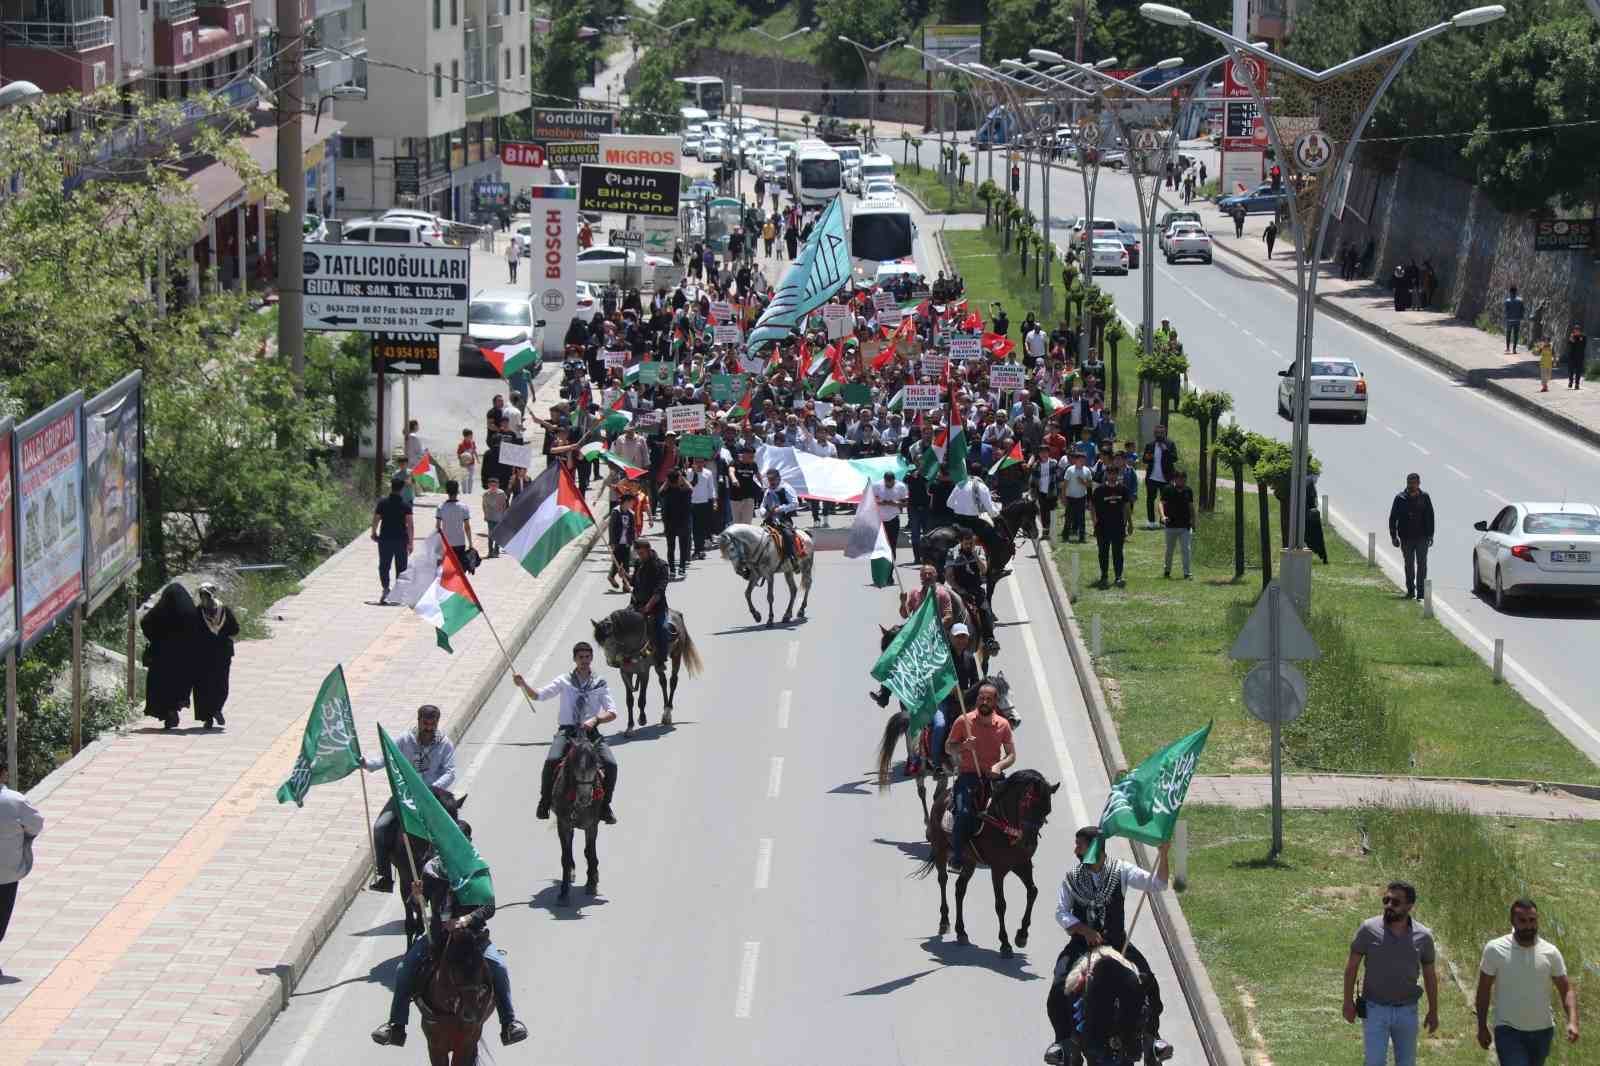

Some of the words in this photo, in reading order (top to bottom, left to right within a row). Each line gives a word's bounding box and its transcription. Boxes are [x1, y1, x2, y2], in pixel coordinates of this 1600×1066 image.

[604, 172, 657, 187] Platin
[597, 187, 664, 201] Bilardo
[546, 209, 561, 279] BOSCH
[324, 253, 466, 279] TATLICIOĞULLARI
[307, 280, 341, 295] GIDA
[366, 284, 392, 297] SAN.
[393, 284, 413, 298] TİC.
[906, 387, 926, 396] THIS
[927, 387, 937, 396] IS
